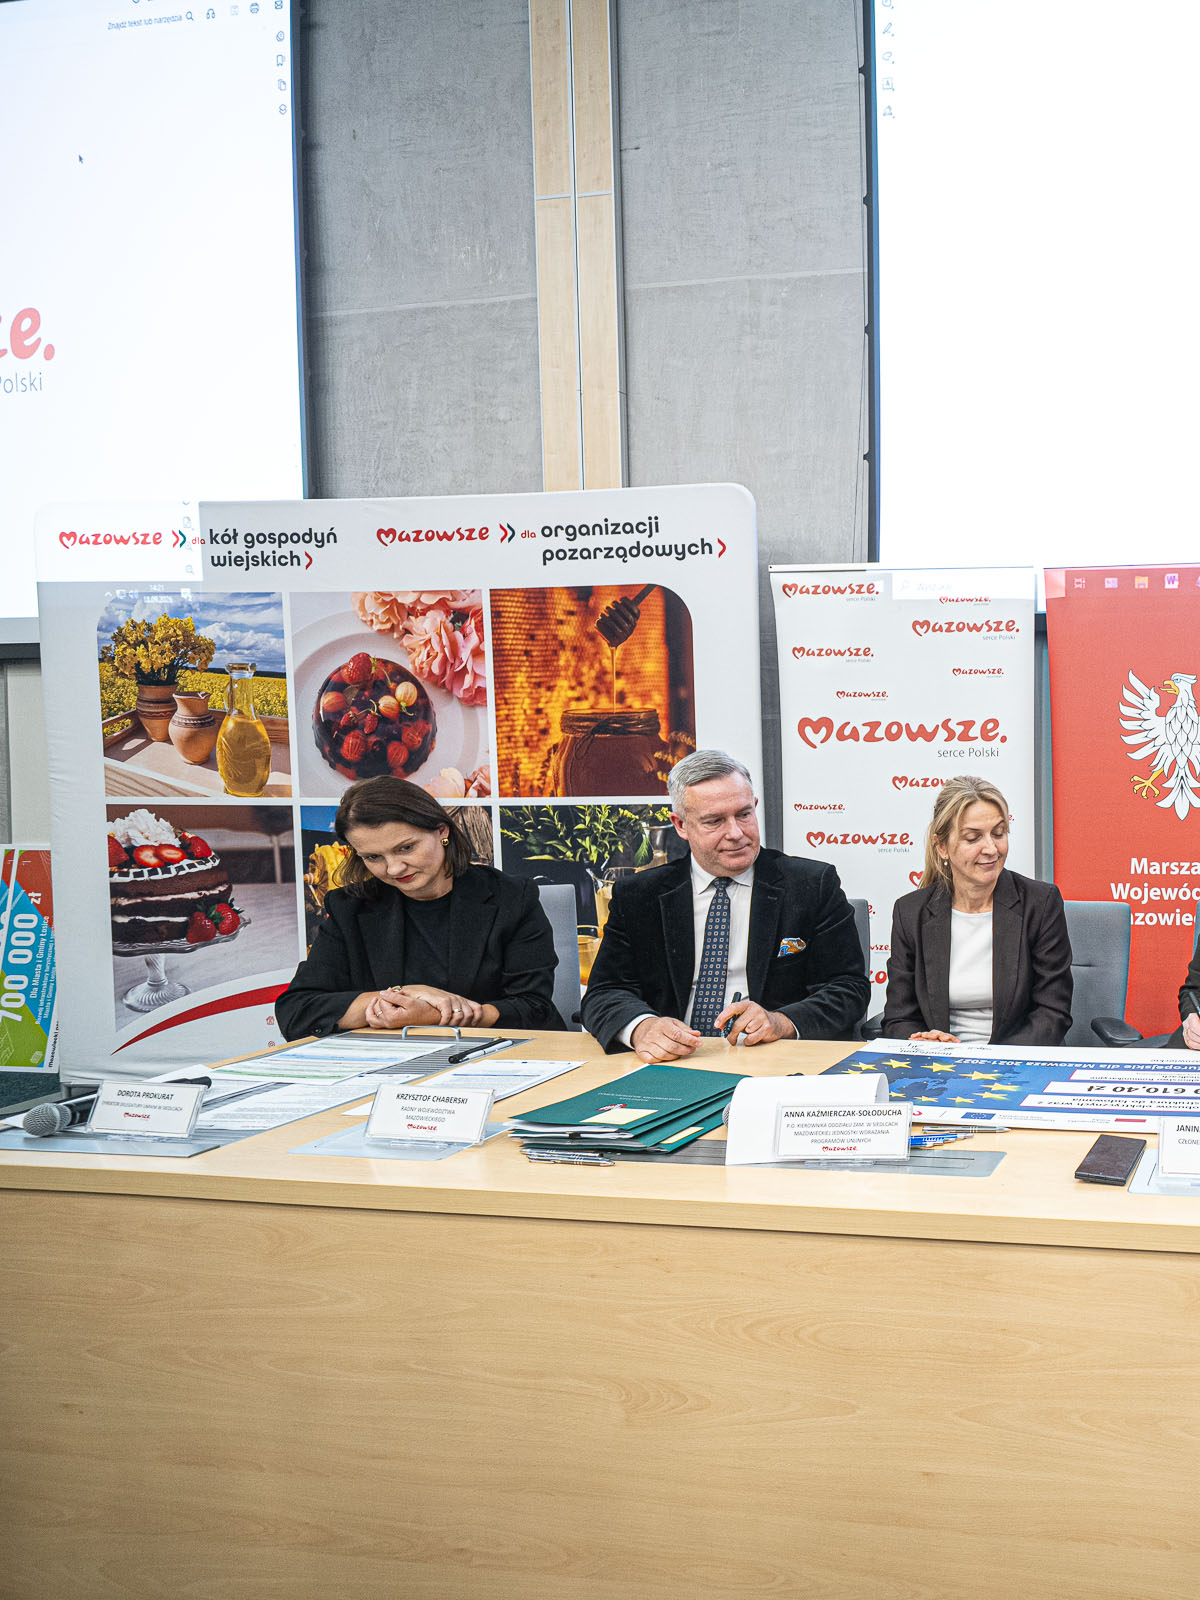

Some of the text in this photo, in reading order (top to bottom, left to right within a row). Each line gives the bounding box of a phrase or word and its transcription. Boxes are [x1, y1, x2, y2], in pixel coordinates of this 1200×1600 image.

[0, 371, 43, 394] olski
[59, 527, 337, 549] Mazowsze dla kół gospodyń
[376, 516, 660, 547] Mazowsze dla organizacji
[542, 538, 714, 566] pozarządowych
[211, 551, 301, 571] wiejskich
[782, 583, 880, 599] Mazowsze.
[912, 619, 1020, 637] Mazowsze.
[792, 646, 874, 660] Mazowsze.
[952, 667, 1004, 677] Mazowsze.
[836, 690, 889, 699] Mazowsze.
[797, 717, 1008, 749] Mazowsze.
[937, 747, 999, 758] serce Polski
[794, 803, 845, 811] Mazowsze.
[806, 831, 914, 848] Mazowsze.
[30, 891, 42, 904] zł
[1130, 909, 1195, 926] zowie
[36, 937, 47, 959] Gminy
[0, 913, 38, 1022] 700 000
[31, 964, 42, 986] Miasta
[30, 987, 38, 999] Dla
[39, 973, 49, 1007] infrastruktury
[43, 1002, 51, 1018] Miasta
[955, 1058, 1023, 1066] 2021-2027
[117, 1089, 174, 1100] DOROTA PROKURAT
[1113, 1086, 1185, 1094] 610,40
[396, 1093, 468, 1104] KRZYSZTOF CHABERSKI
[406, 1114, 446, 1122] MAZOWIECKIEGO
